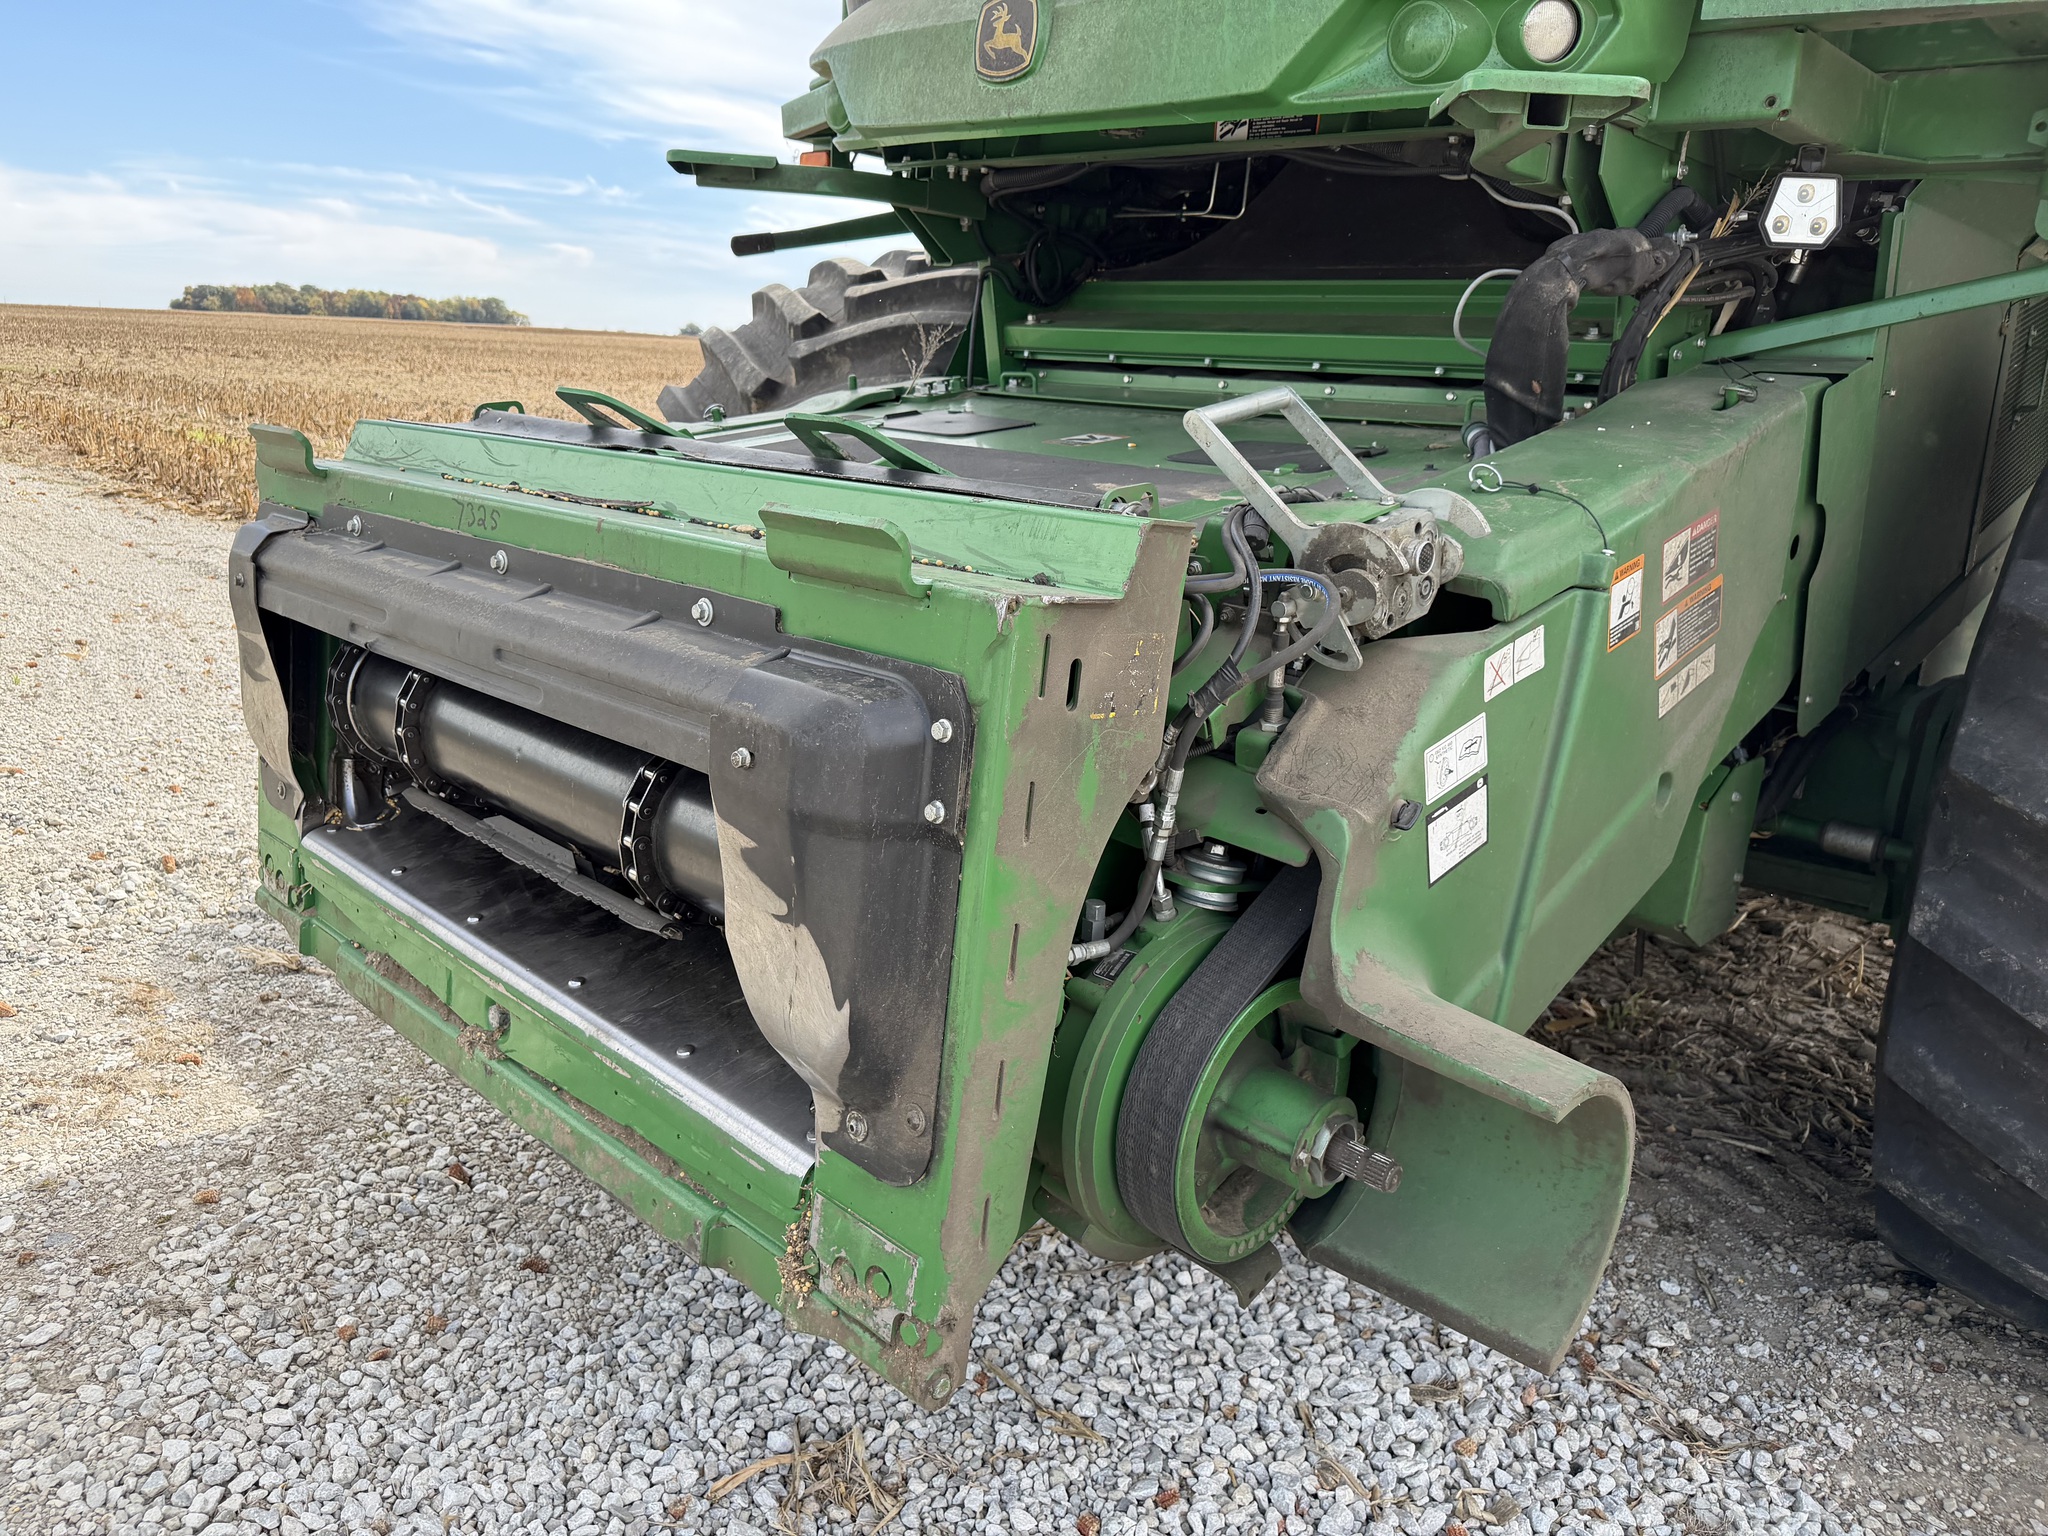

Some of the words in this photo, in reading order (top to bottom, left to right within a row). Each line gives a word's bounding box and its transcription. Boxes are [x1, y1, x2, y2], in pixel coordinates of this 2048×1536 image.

[452, 498, 500, 530] 7325
[1696, 514, 1717, 532] DANGER
[1619, 559, 1640, 576] WARNING
[1269, 575, 1300, 583] RESISTANT
[1690, 584, 1712, 602] WARNING
